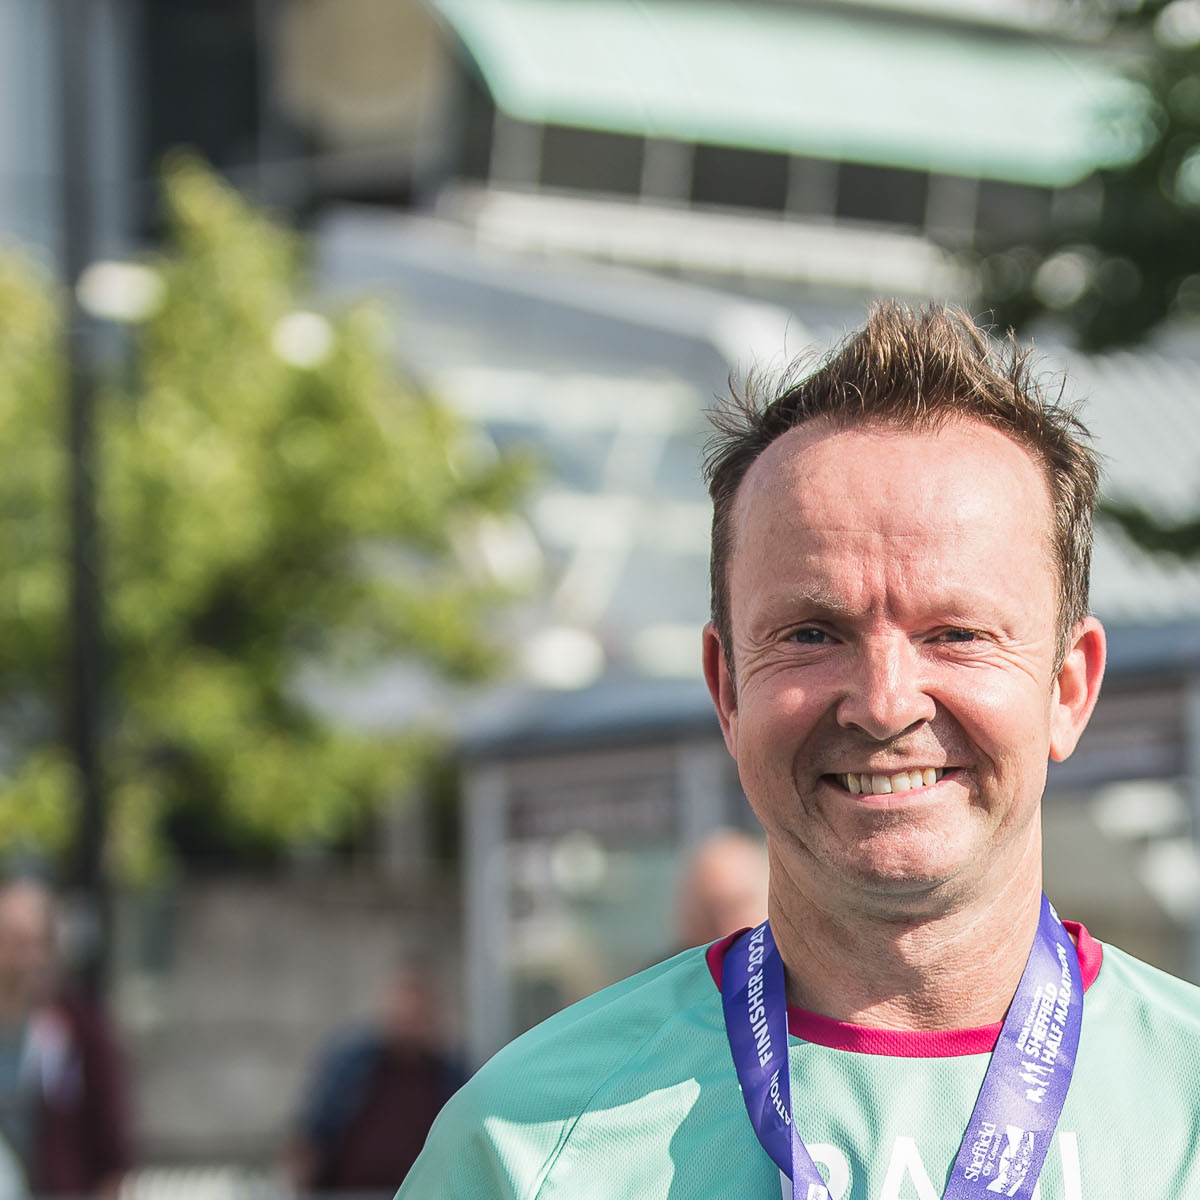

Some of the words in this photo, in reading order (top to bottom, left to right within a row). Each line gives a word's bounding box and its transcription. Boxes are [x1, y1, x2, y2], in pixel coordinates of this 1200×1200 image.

[748, 925, 767, 973] 2020
[748, 968, 773, 1068] FINISHER
[1024, 982, 1058, 1059] SHEFFIELD
[1040, 1022, 1065, 1065] HALF
[1054, 942, 1073, 1025] MARATHON
[964, 1121, 997, 1182] Sheffield
